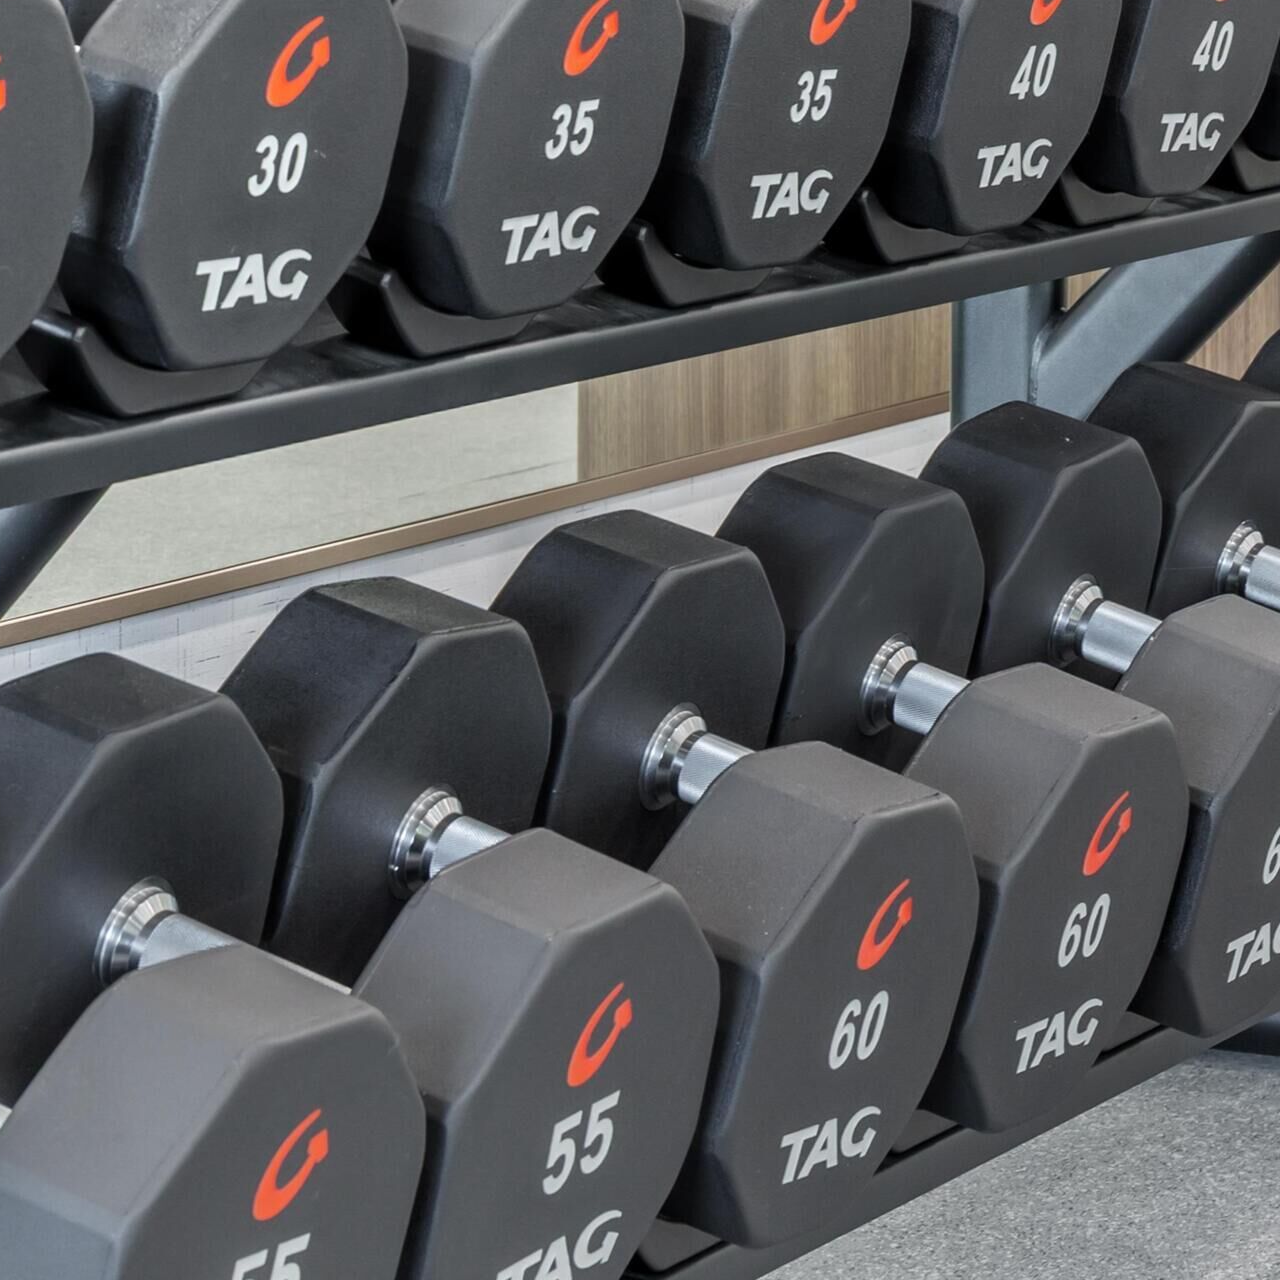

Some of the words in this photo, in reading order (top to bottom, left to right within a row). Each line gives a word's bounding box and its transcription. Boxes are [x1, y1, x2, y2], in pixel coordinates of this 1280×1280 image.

[790, 69, 838, 122] 35
[1010, 43, 1056, 100] 40
[545, 99, 600, 159] 35
[248, 133, 307, 196] 30
[978, 139, 1052, 188] TAG
[751, 170, 833, 219] TAG
[501, 206, 599, 265] TAG
[196, 249, 312, 311] TAG
[829, 991, 888, 1069] 60
[543, 1090, 620, 1194] 55
[781, 1106, 881, 1184] TAG
